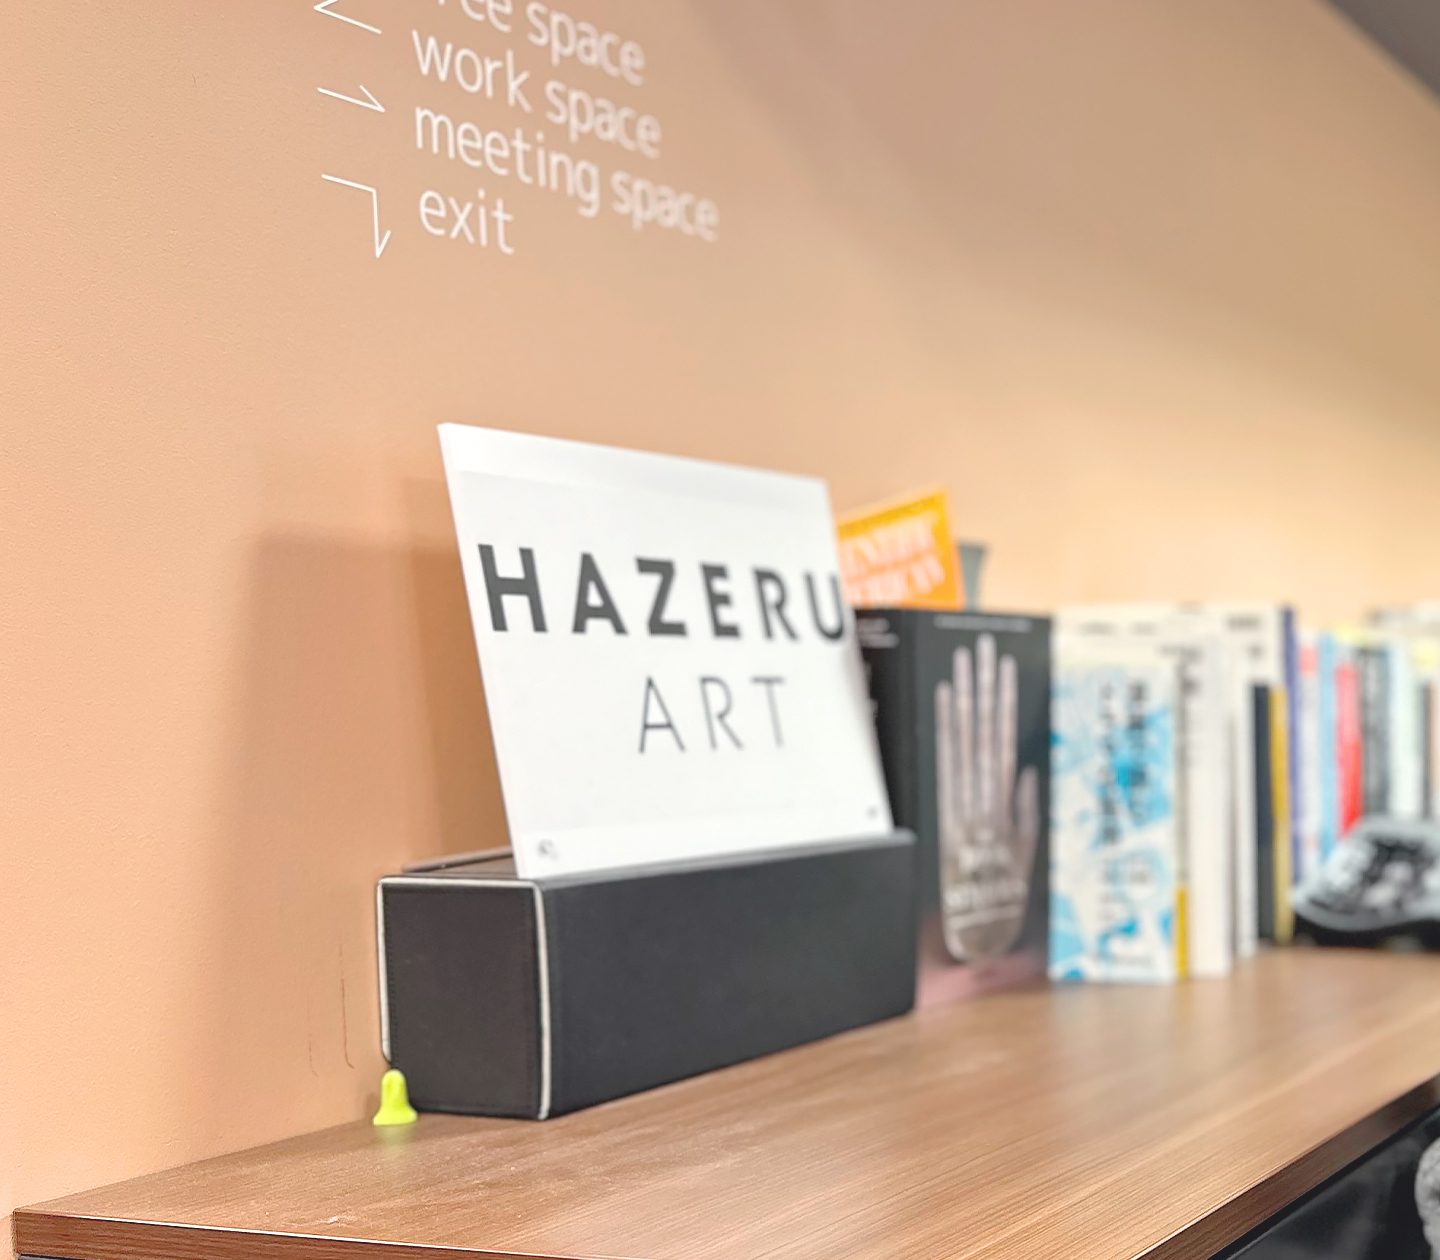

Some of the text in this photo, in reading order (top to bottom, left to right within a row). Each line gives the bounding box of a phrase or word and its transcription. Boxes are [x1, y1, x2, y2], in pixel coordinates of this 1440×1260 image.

[525, 1, 645, 85] space
[412, 29, 661, 159] work space
[415, 106, 719, 242] meeting space
[419, 189, 515, 255] exit
[477, 543, 846, 643] HAZERU
[638, 675, 786, 754] ART
